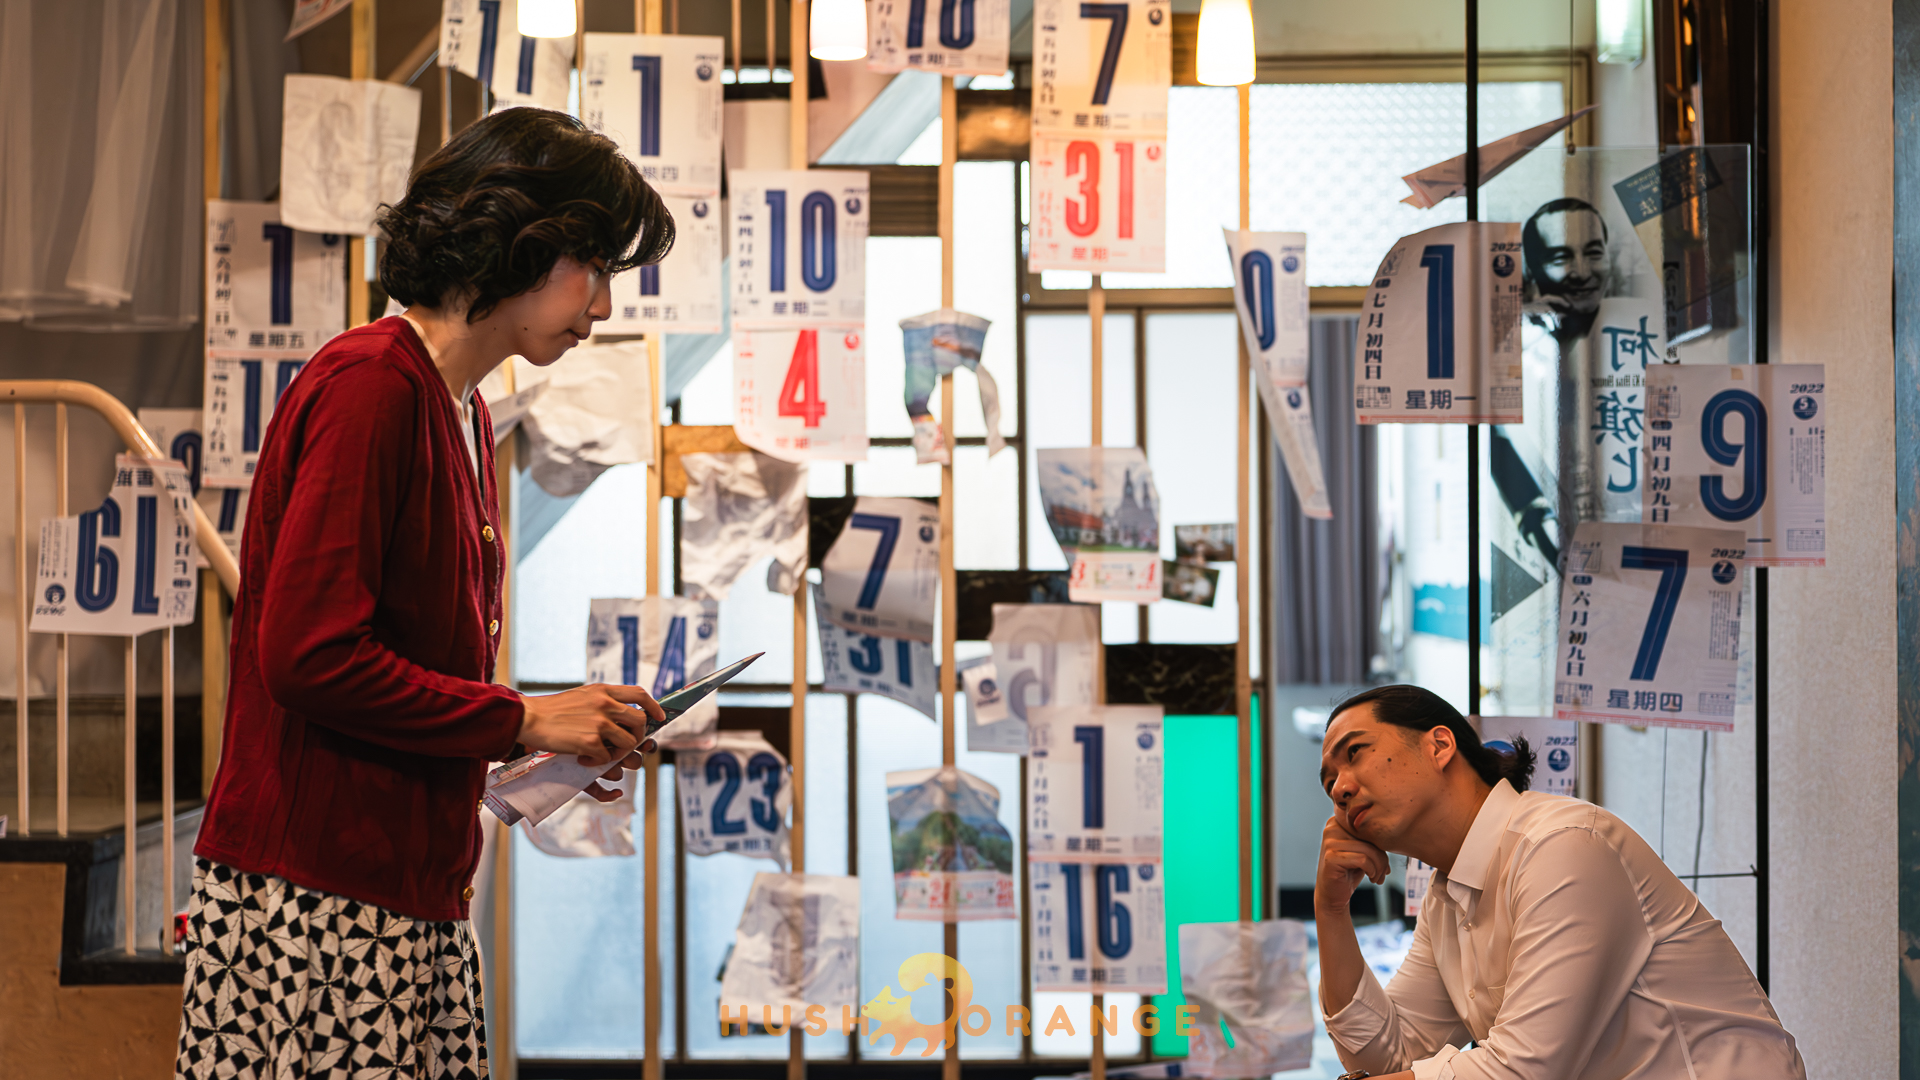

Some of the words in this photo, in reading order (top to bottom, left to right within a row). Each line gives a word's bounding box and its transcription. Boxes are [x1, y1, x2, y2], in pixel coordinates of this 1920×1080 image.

[1080, 3, 1129, 106] 7
[632, 55, 662, 157] 1
[1065, 140, 1134, 240] 31
[262, 221, 294, 326] 1
[765, 190, 836, 293] 10
[248, 332, 305, 348] 星期五
[1364, 292, 1387, 380] 七月初四日
[1419, 244, 1455, 380] 1
[778, 330, 828, 429] 4
[1405, 389, 1477, 410] 星期一
[1789, 383, 1824, 395] 2022
[1652, 435, 1672, 523] 四月初九日
[1700, 388, 1768, 522] 9
[75, 495, 161, 615] 19
[851, 512, 902, 611] 7
[1711, 547, 1746, 559] 2022
[617, 616, 687, 702] 14
[1566, 590, 1592, 677] 六月初九日
[1621, 545, 1690, 682] 7
[1545, 736, 1578, 746] 2022
[1607, 688, 1683, 713] 星期四
[706, 751, 782, 835] 23
[1074, 725, 1104, 829] 1
[1060, 863, 1133, 961] 16
